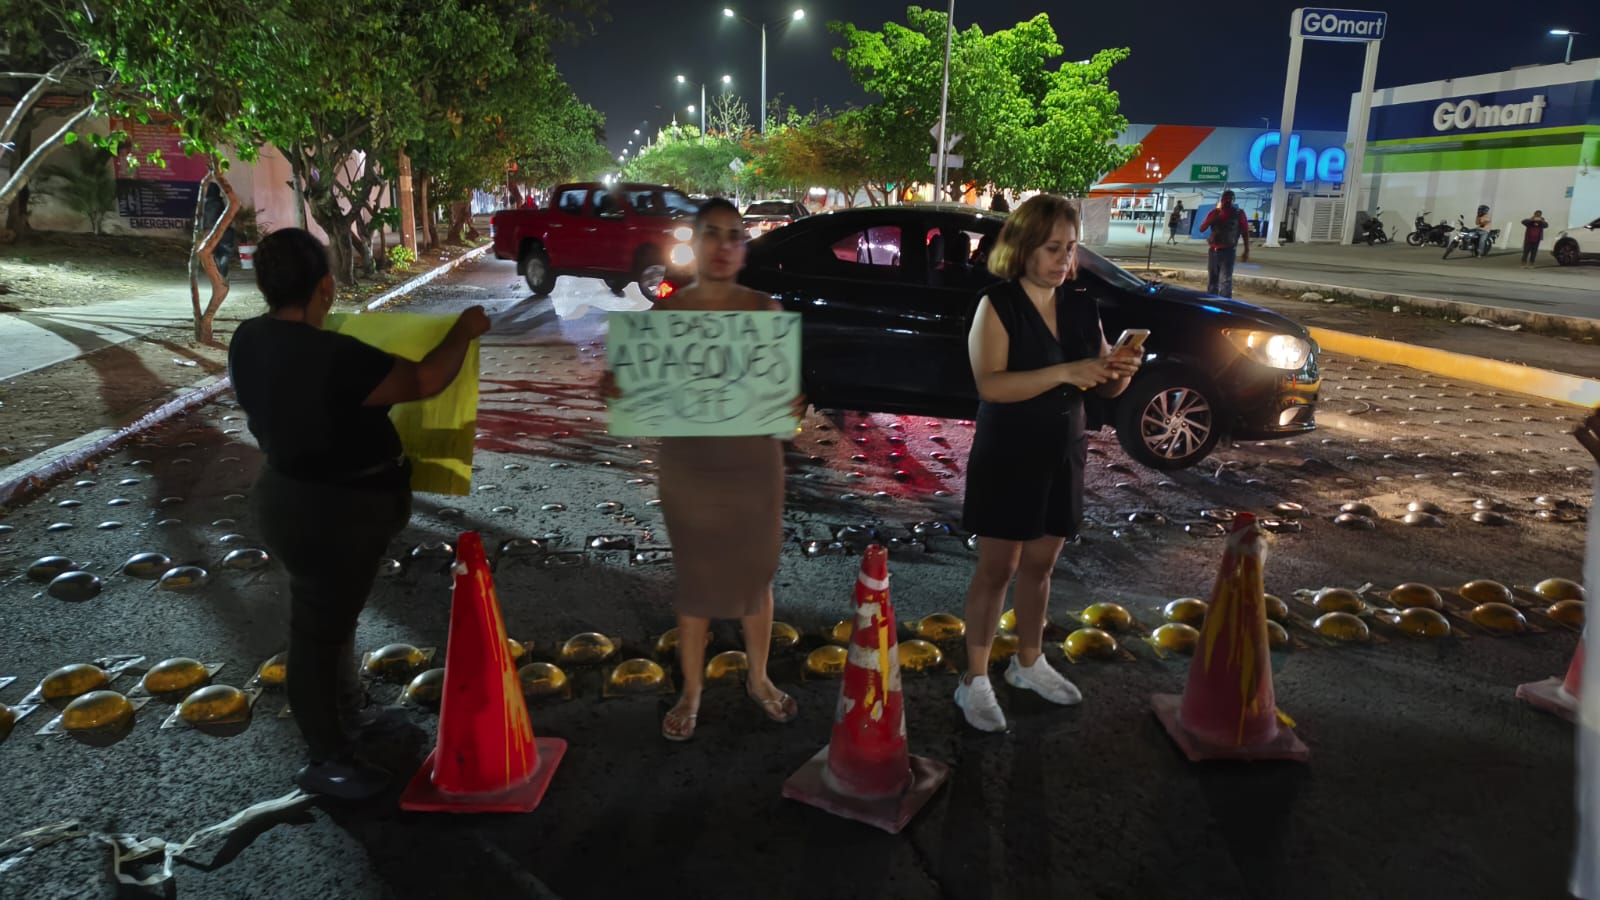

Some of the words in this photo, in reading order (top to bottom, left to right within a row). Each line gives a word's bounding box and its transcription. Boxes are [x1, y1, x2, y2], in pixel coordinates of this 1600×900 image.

[1304, 13, 1382, 35] GOmart
[1433, 95, 1546, 131] GOmart
[131, 219, 190, 229] EMERGENCI
[667, 312, 760, 342] BASTA
[614, 342, 791, 385] APAGONES
